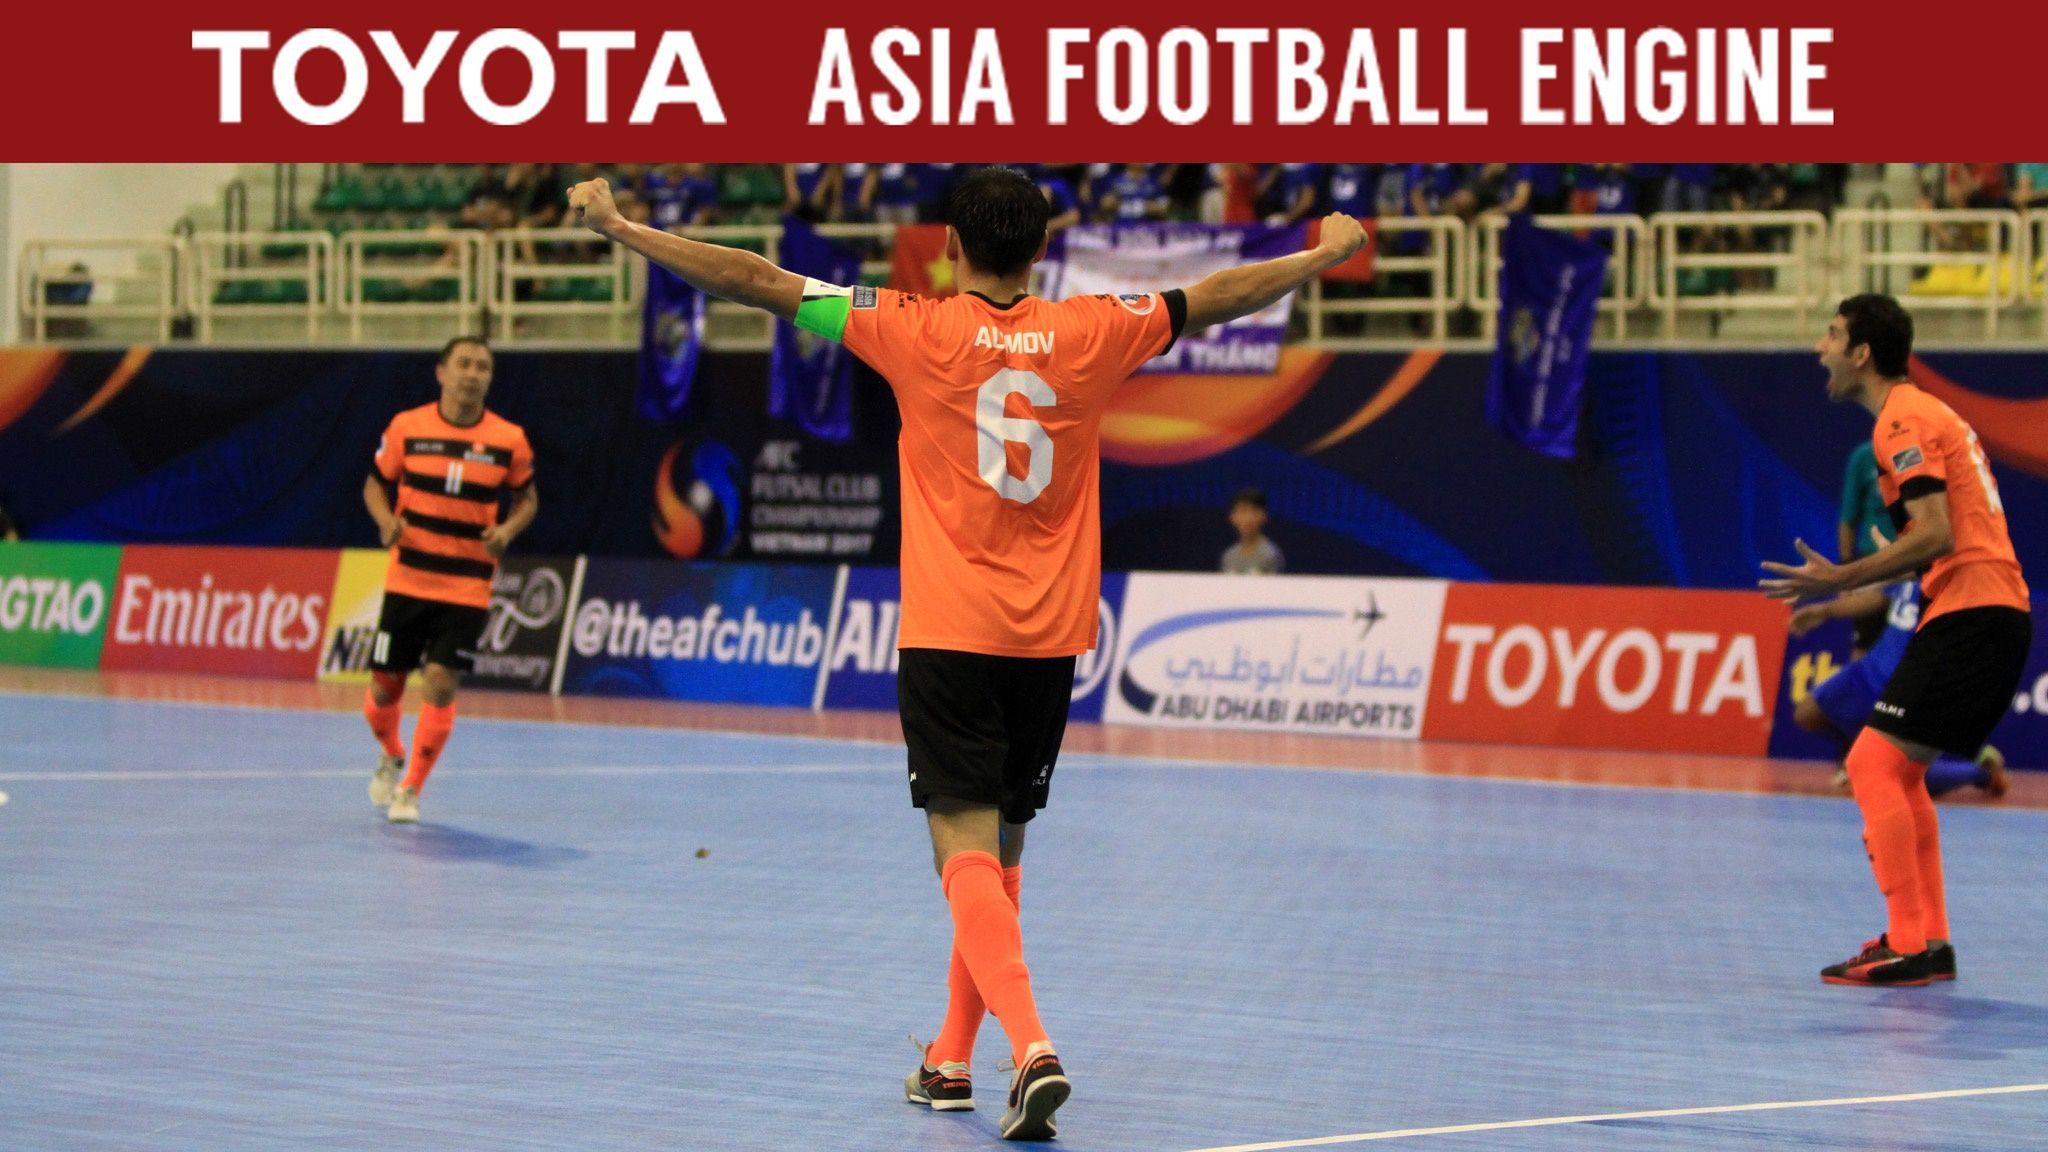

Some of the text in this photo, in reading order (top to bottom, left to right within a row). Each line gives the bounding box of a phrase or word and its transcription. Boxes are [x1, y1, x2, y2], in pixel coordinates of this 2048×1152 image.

[974, 325, 1055, 354] ALMOV
[976, 367, 1056, 504] 6
[445, 461, 464, 495] 11
[0, 575, 105, 635] GTAO
[114, 572, 324, 651] Emirates
[572, 597, 825, 669] @theafchub
[1444, 624, 1765, 718] TOYOTA
[1160, 693, 1415, 731] ABU DHABI AIRPORTS
